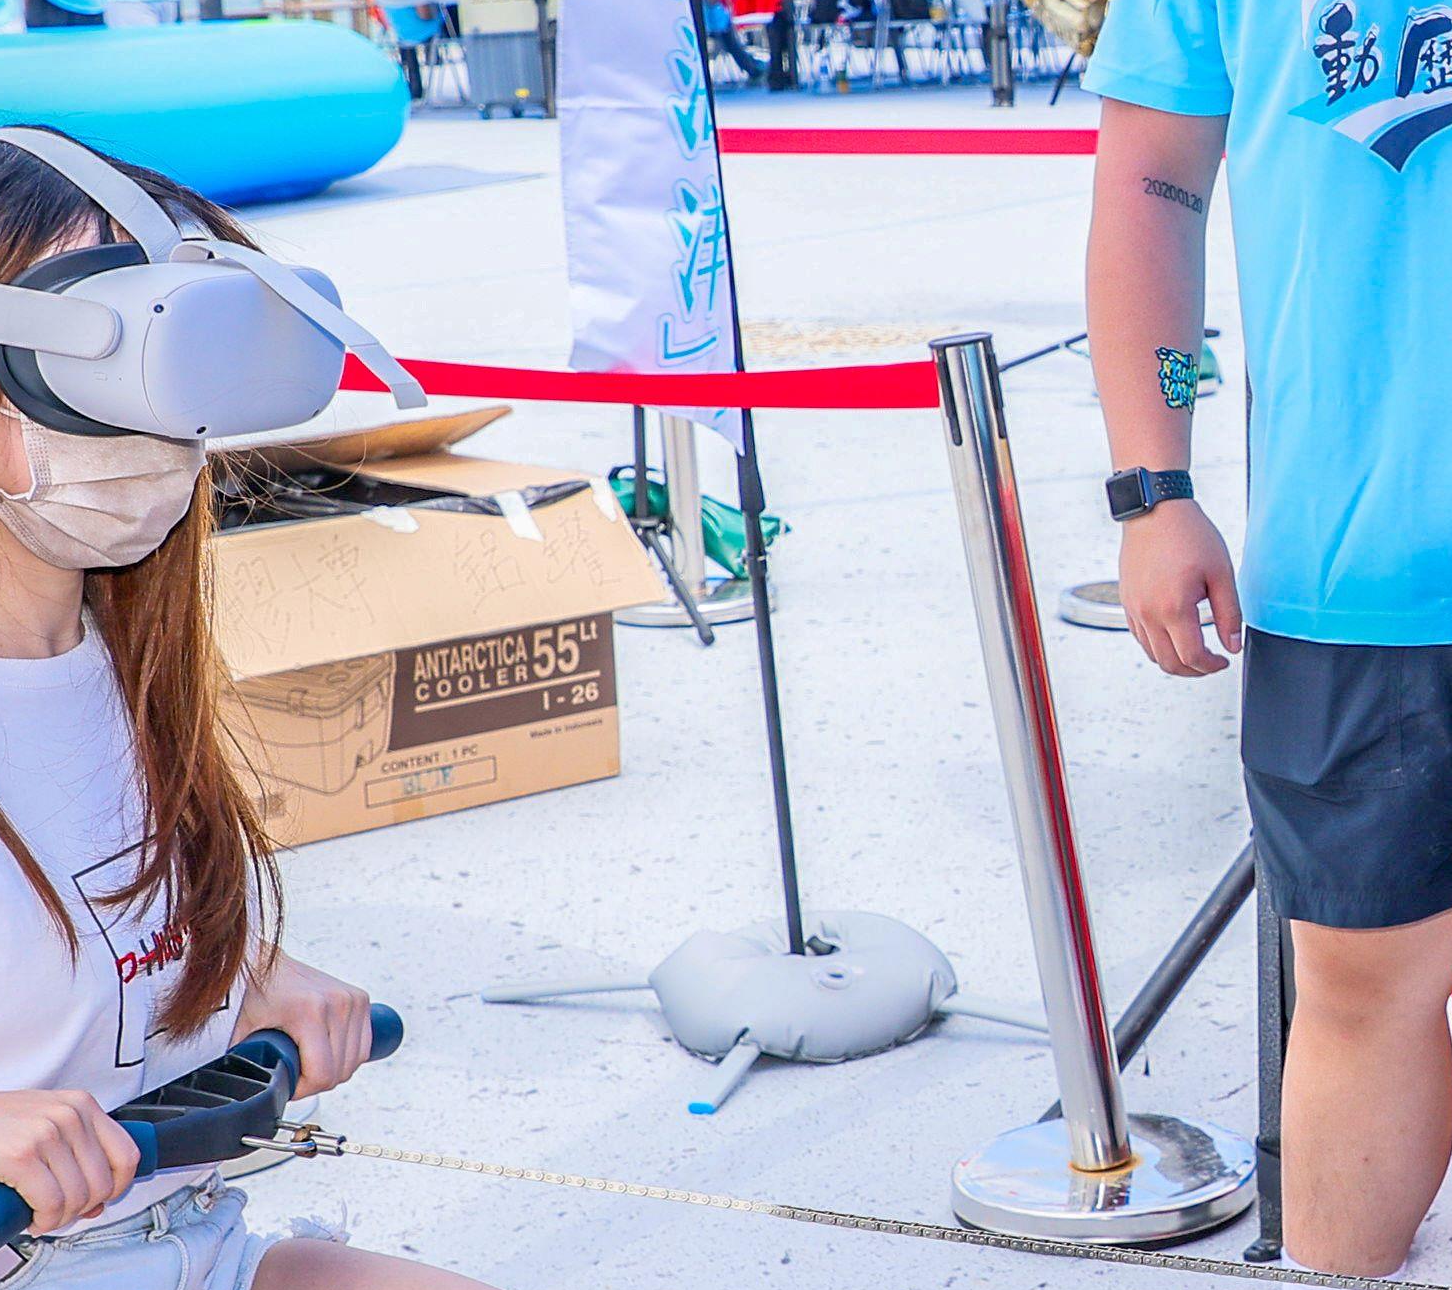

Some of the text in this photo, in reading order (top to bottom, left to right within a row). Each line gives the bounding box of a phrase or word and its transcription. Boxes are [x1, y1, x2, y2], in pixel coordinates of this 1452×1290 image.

[413, 634, 528, 683] ANTARCTICA
[414, 664, 528, 702] COOLER
[381, 752, 440, 773] CONTENT
